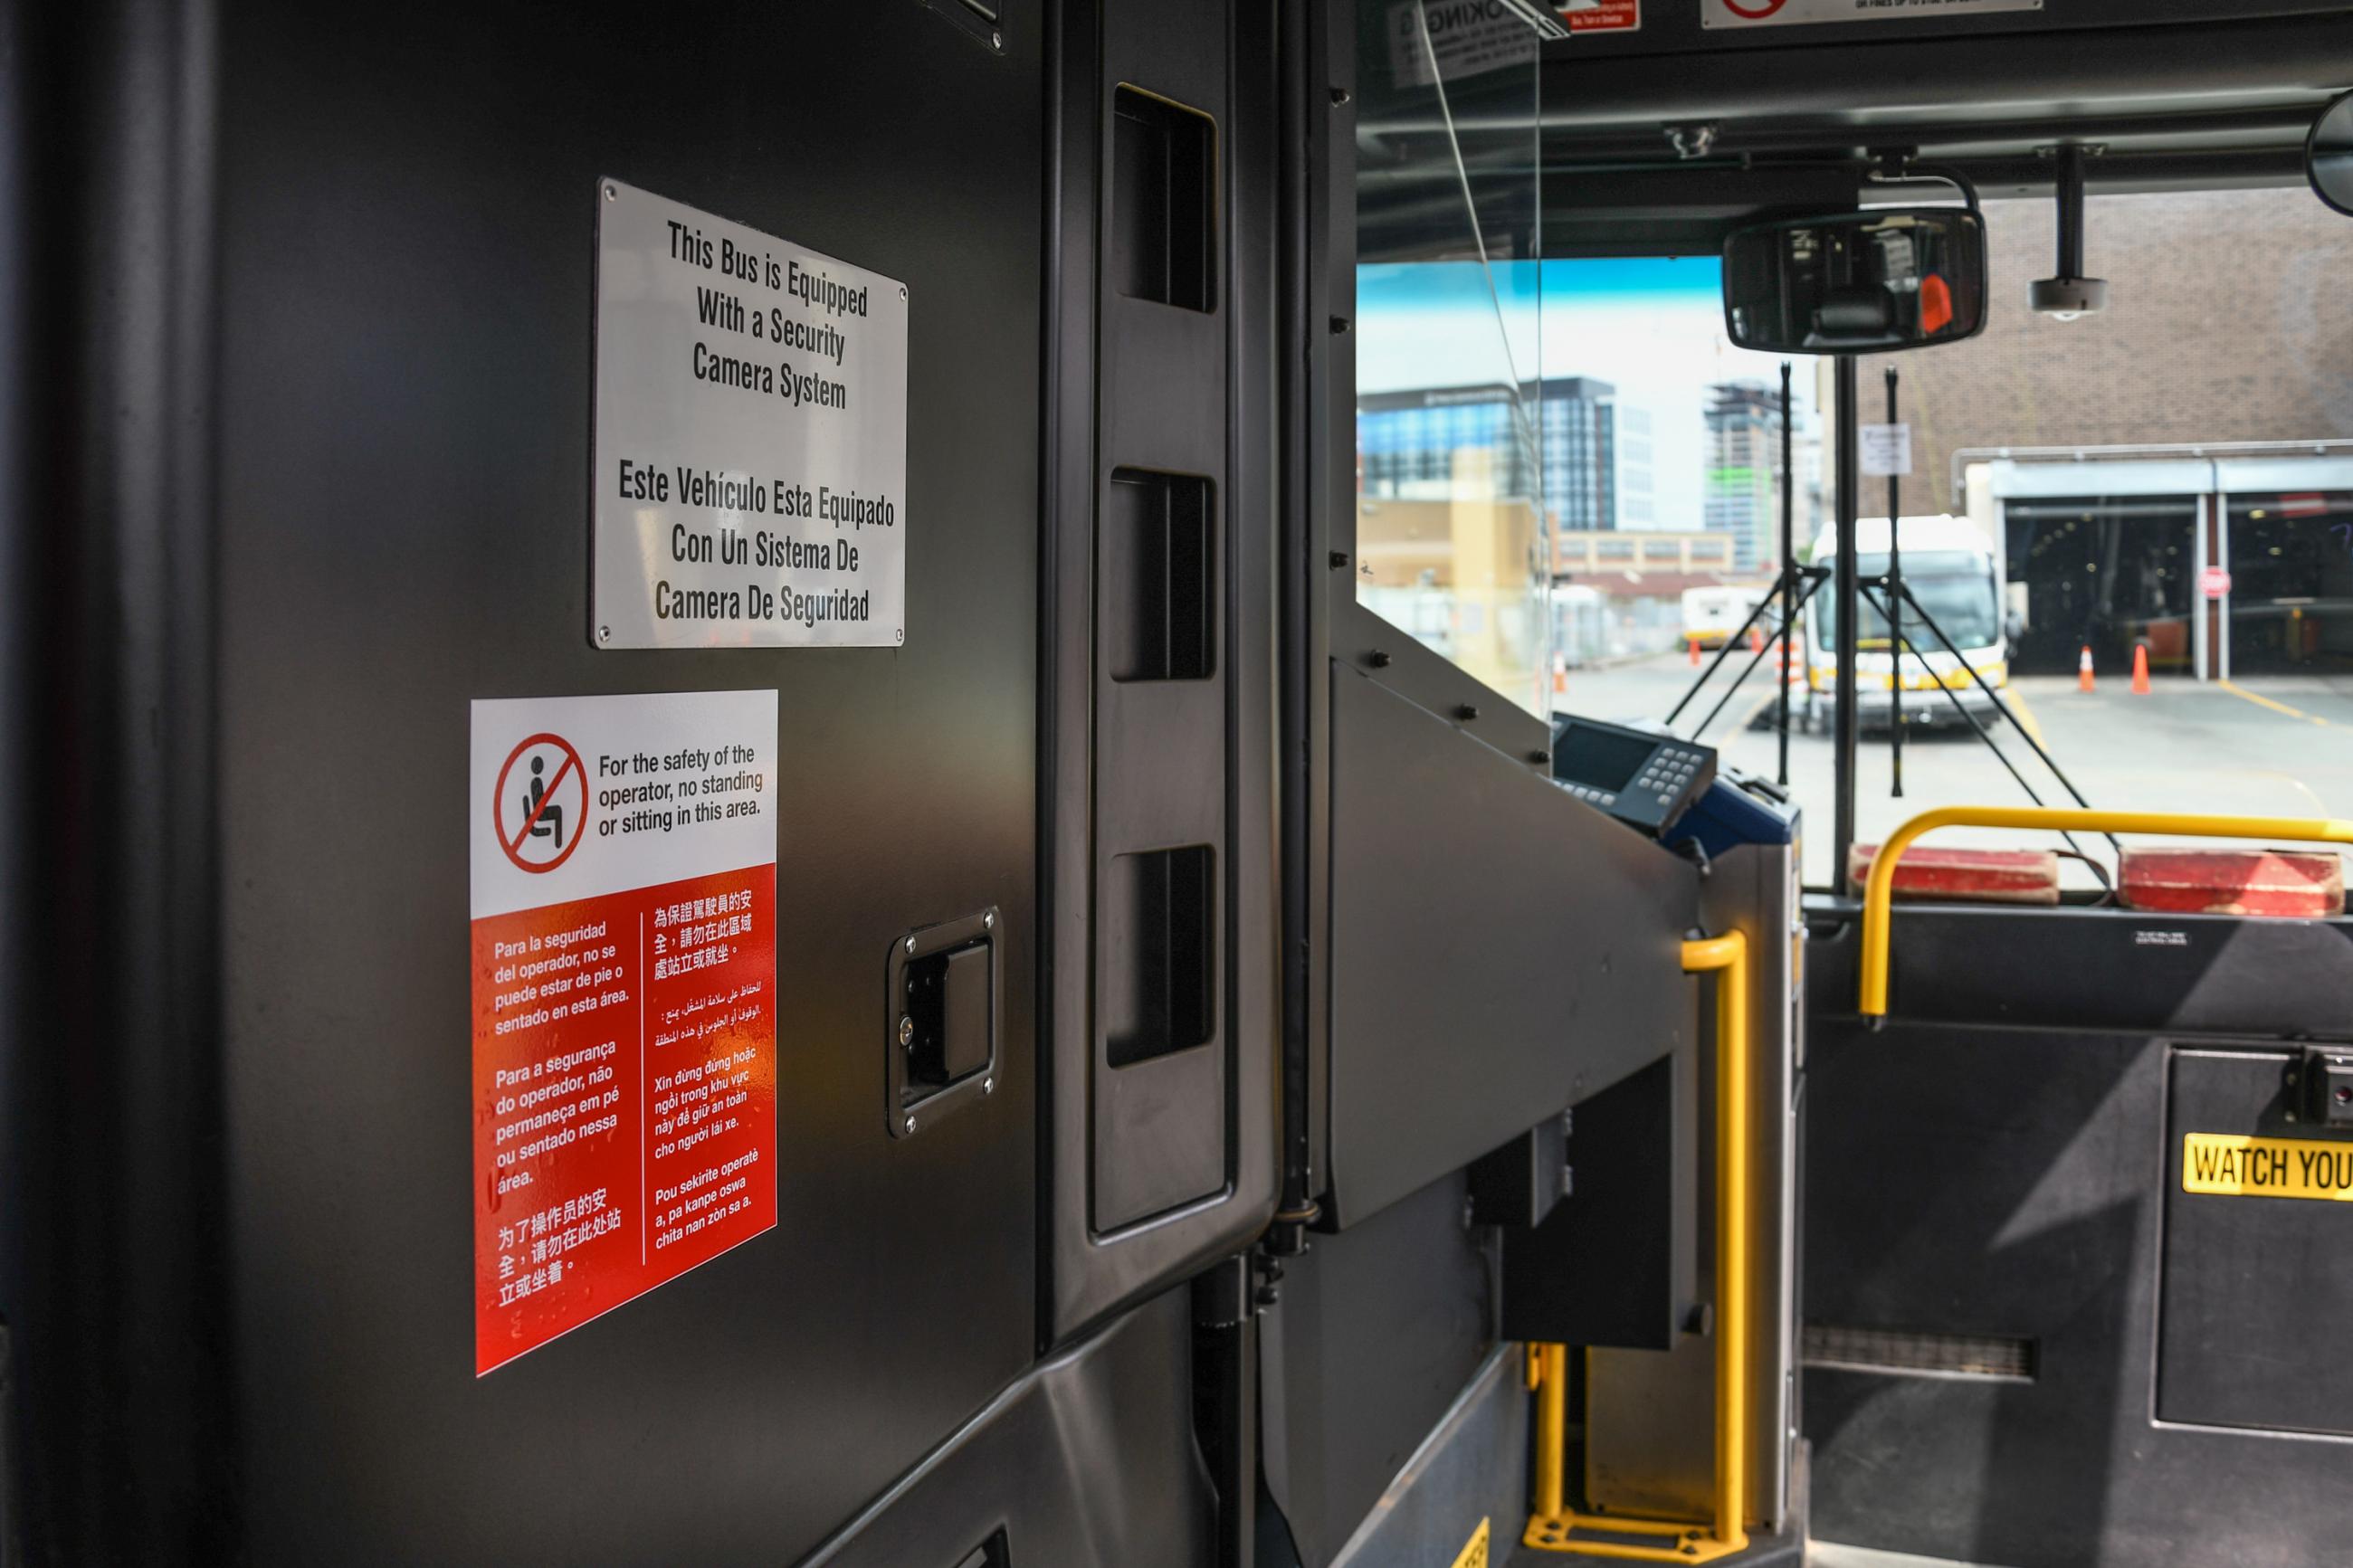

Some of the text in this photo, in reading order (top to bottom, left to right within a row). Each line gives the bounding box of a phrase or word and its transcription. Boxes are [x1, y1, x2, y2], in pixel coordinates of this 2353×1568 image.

[668, 220, 867, 318] This Bus is Equipped
[697, 286, 844, 366] With a Security
[693, 342, 846, 409] Camera System
[619, 459, 894, 530] Este Vehículo Esta Equipado
[672, 523, 859, 572] Con Un Sistema De
[656, 580, 869, 628] Camera De Seguridad
[599, 745, 755, 777] For the safety of the
[599, 771, 763, 811] operator, no standing
[599, 800, 760, 836] or sitting in this area.
[654, 889, 752, 928] 為保證駕駛員的安
[495, 921, 606, 959] Para la seguridad
[495, 945, 616, 984] del operador, no se
[495, 965, 623, 1012] puede estar de pie o
[708, 993, 726, 1006] سلامة
[728, 989, 738, 1003] على
[740, 981, 761, 997] للحفاظ
[495, 990, 629, 1035] sentado en esta área.
[681, 1026, 695, 1040] هذه
[697, 1022, 703, 1039] في
[705, 1014, 729, 1034] الجلوس
[654, 1030, 679, 1047] المنطقة
[496, 1041, 616, 1088] Para a segurança
[654, 1075, 672, 1093] Xin
[496, 1065, 613, 1116] do operador, não
[681, 1085, 708, 1105] trong
[710, 1078, 729, 1094] khu
[496, 1085, 619, 1145] permaneça em pé
[655, 1117, 674, 1136] này
[711, 1099, 724, 1114] an
[727, 1089, 748, 1108] toàn
[497, 1114, 617, 1168] ou sentado nessa
[655, 1142, 675, 1159] cho
[711, 1119, 722, 1136] lái
[725, 1117, 739, 1131] xe.
[498, 1171, 533, 1194] área.
[655, 1185, 678, 1205] Pou
[680, 1168, 719, 1193] sekirite
[2195, 1145, 2288, 1187] WATCH
[499, 1187, 607, 1252] 为了操作员的安
[655, 1176, 746, 1228] a, pa kanpe oswa
[656, 1195, 752, 1249] chita nan zòn sa a.
